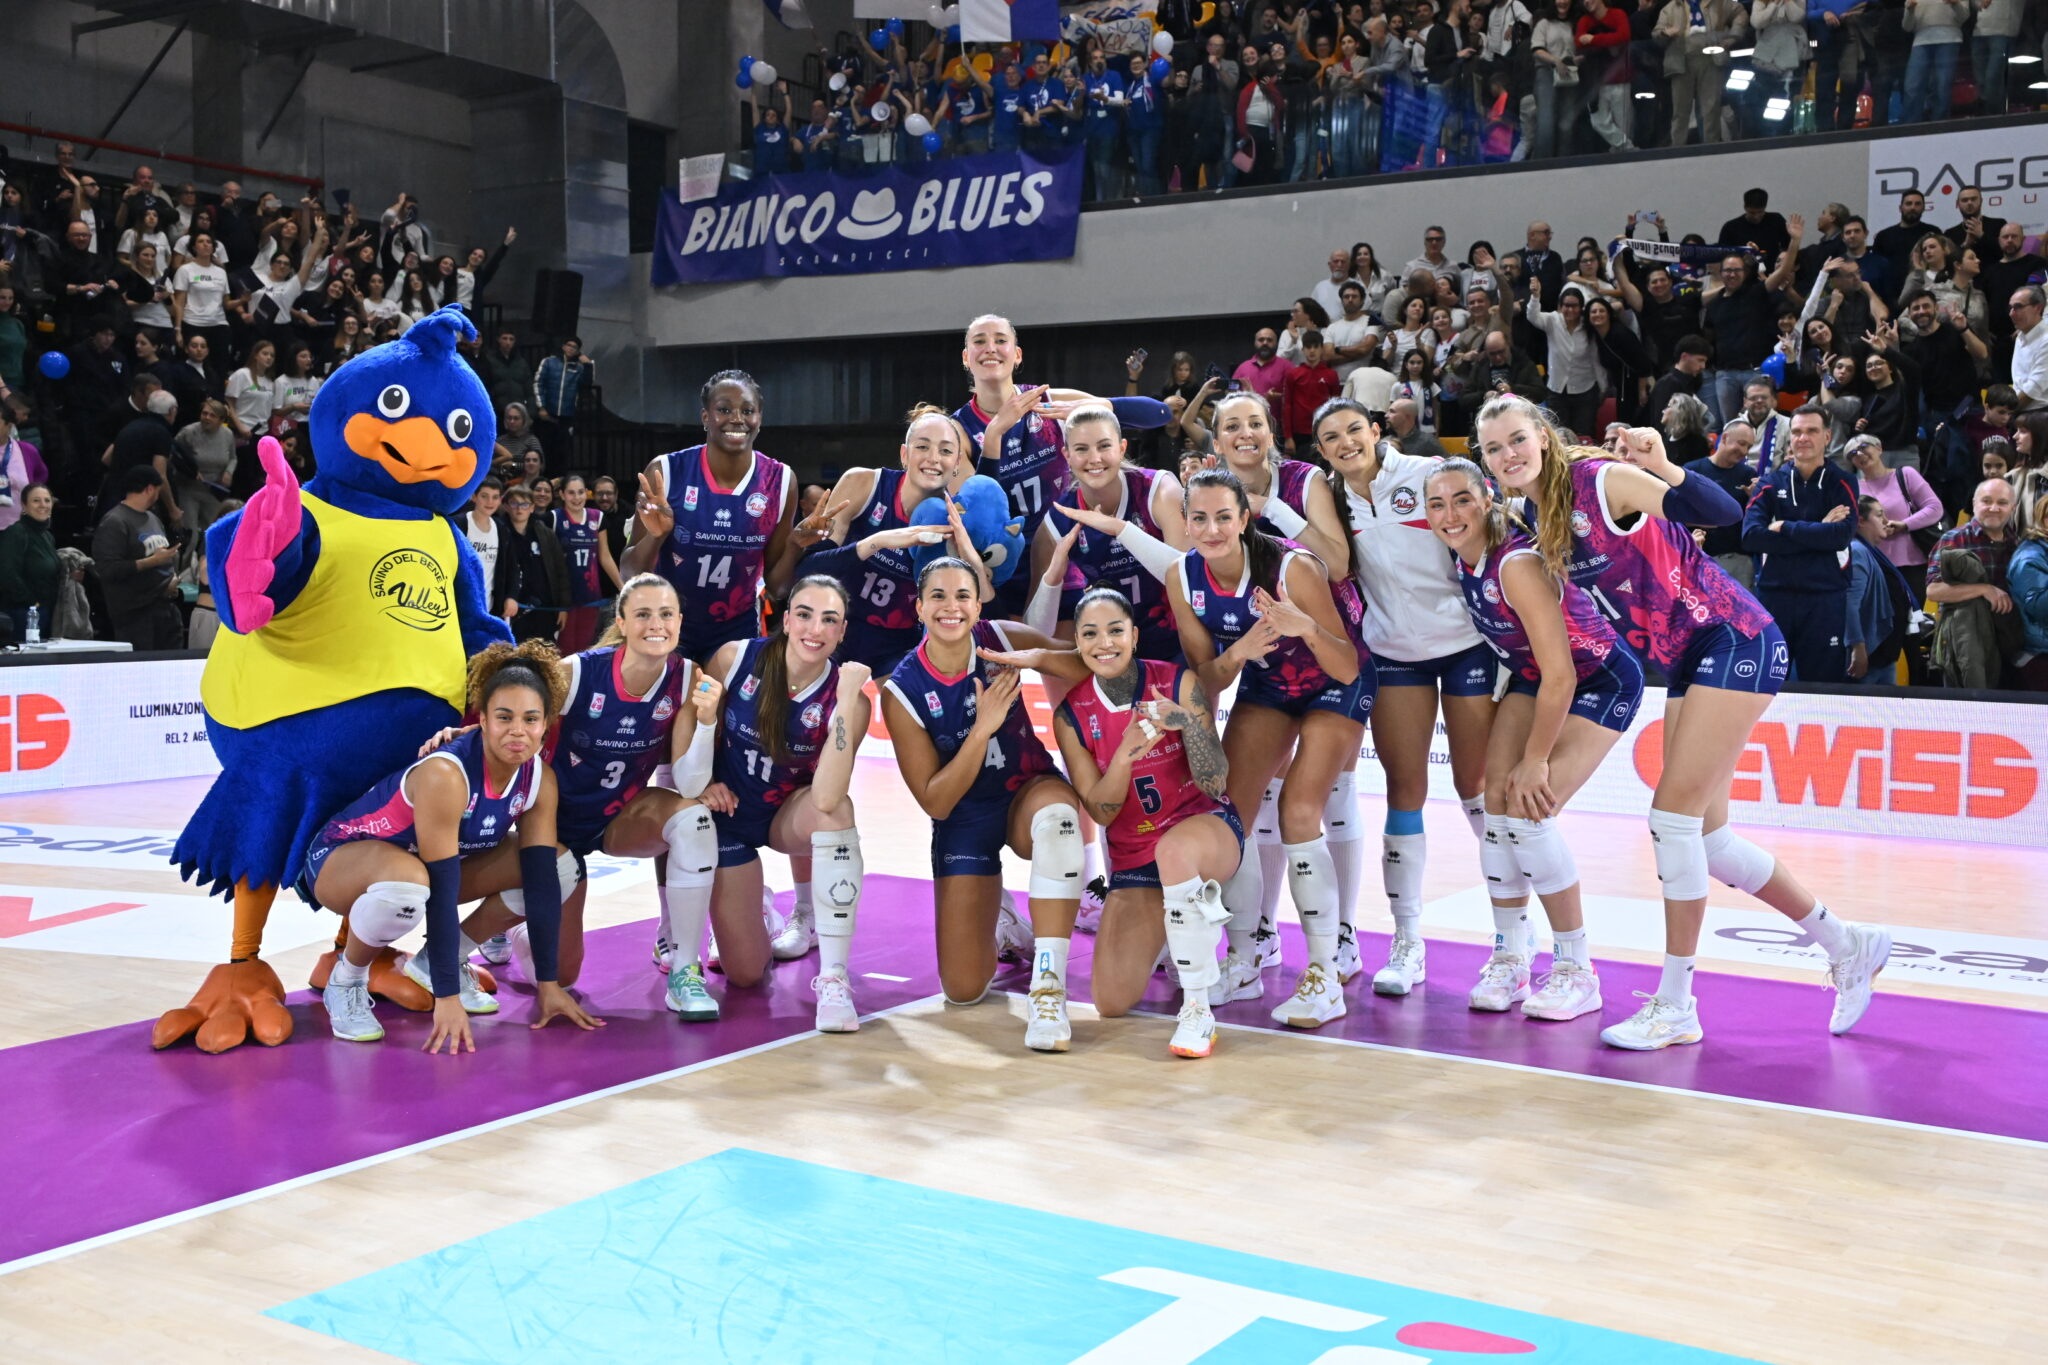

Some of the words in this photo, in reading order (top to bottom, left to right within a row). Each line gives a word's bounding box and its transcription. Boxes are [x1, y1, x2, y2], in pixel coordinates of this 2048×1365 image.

[681, 190, 836, 256] BIANCO
[908, 170, 1053, 236] BLUES
[1024, 454, 1038, 464] DEL
[1039, 445, 1057, 458] BENE
[1010, 475, 1042, 516] 17
[695, 532, 726, 541] SAVINO
[746, 535, 766, 543] BENE
[574, 549, 590, 567] 17
[697, 554, 733, 589] 14
[873, 552, 895, 566] AVINO
[896, 562, 910, 574] DEL
[1577, 559, 1590, 570] DEL
[374, 561, 394, 598] SAVINO
[393, 554, 417, 565] DEL
[419, 556, 445, 584] BENE
[860, 571, 896, 608] 13
[1119, 574, 1142, 605] 7
[387, 581, 443, 617] Volley
[165, 732, 181, 744] REL
[183, 732, 188, 743] 2
[596, 739, 628, 748] SAVINO
[631, 740, 646, 748] DEL
[985, 736, 1006, 770] 4
[600, 760, 626, 789] 3
[743, 749, 773, 783] 11
[1133, 774, 1163, 816] 5
